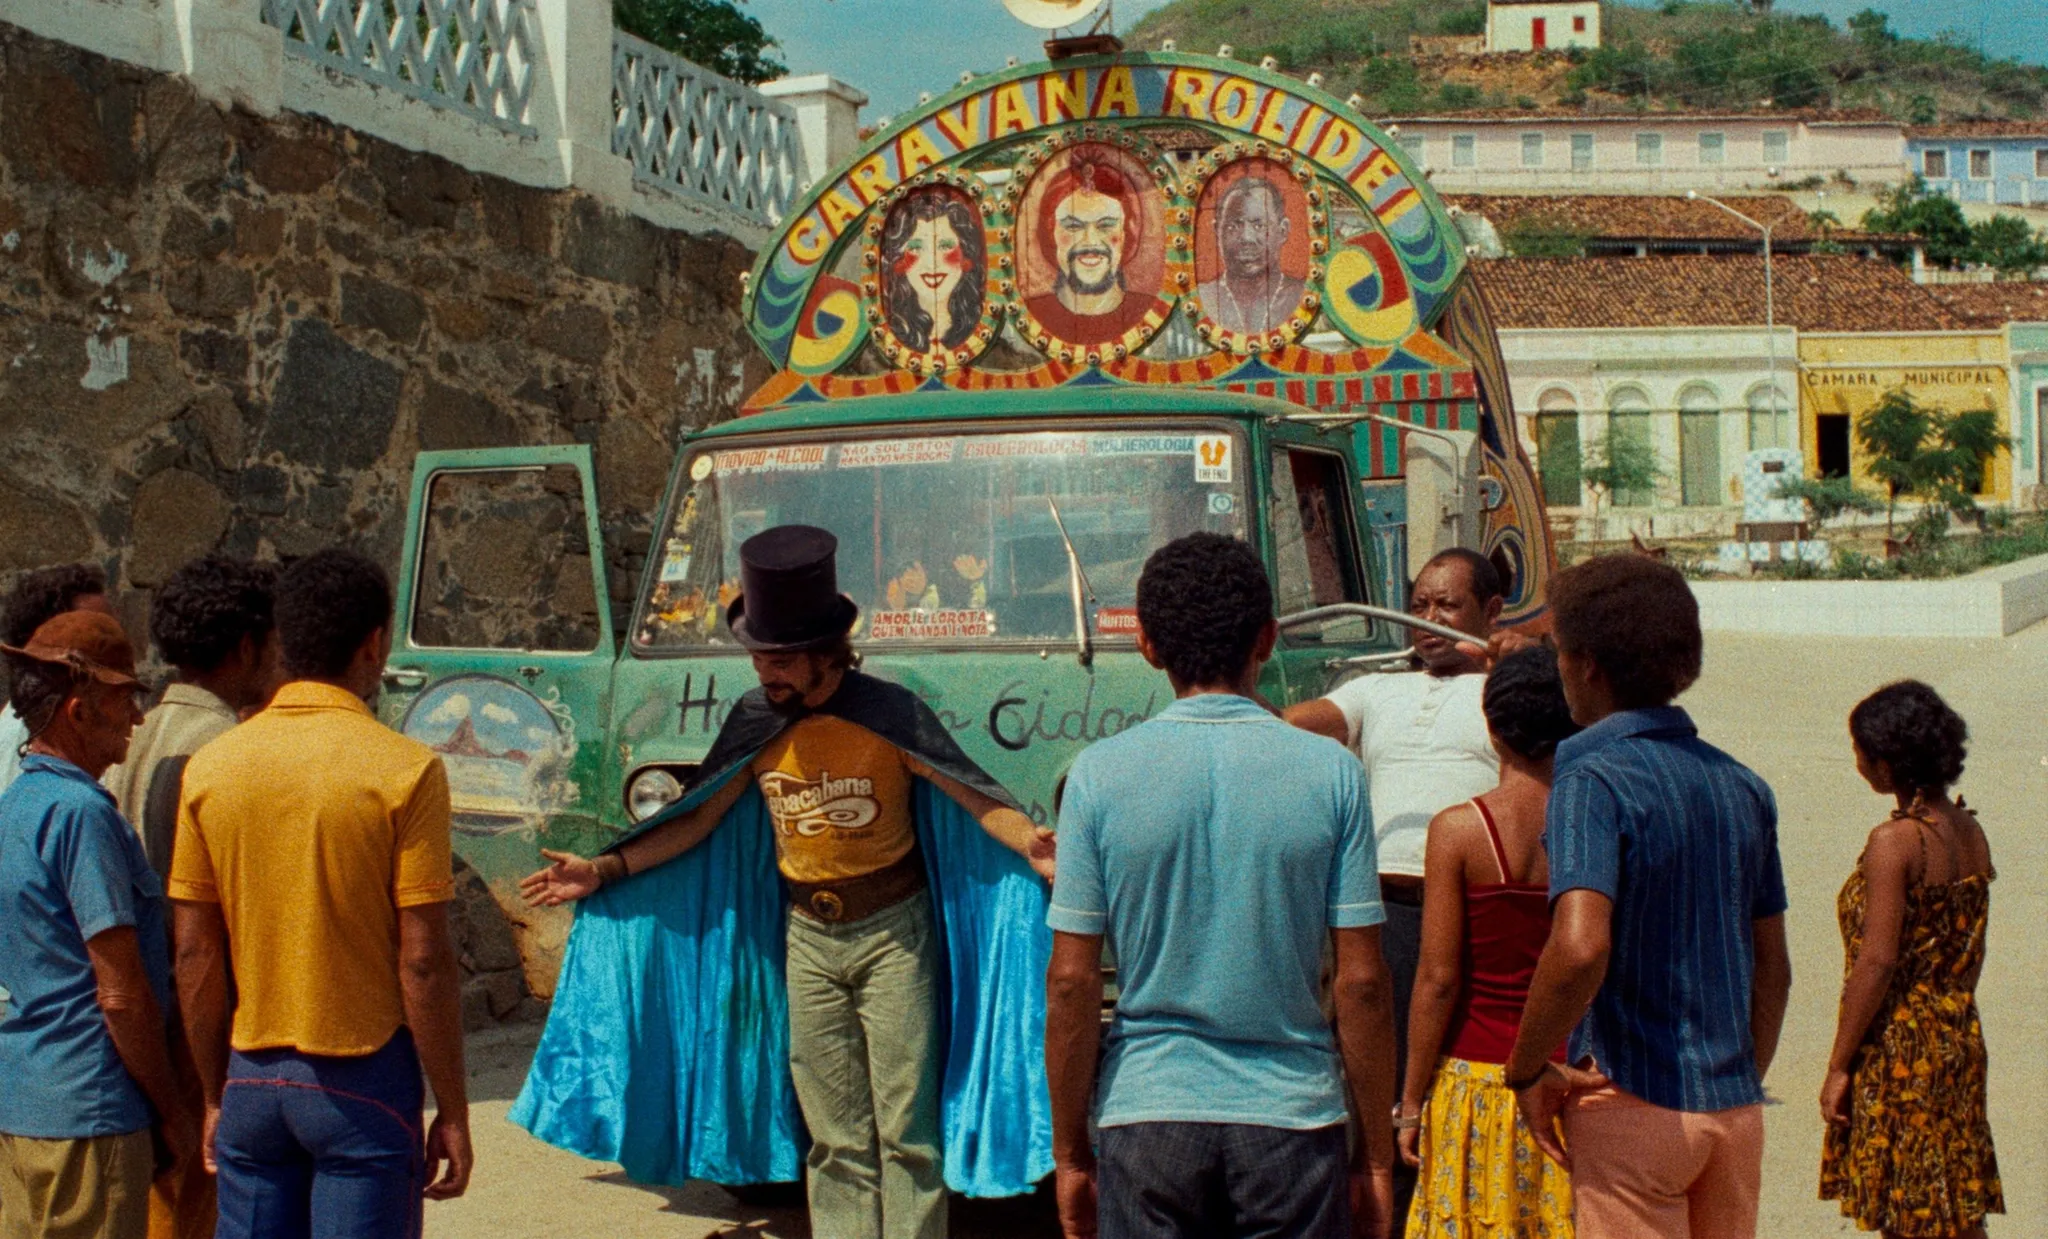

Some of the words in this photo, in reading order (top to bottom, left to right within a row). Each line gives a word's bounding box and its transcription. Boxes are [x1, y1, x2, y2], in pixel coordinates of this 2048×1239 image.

[787, 65, 1140, 266] CARAVANA
[1161, 67, 1422, 226] ROLIDEI
[1904, 370, 1993, 385] MUNICIPAL
[713, 450, 768, 470] MOVIDO
[874, 612, 911, 625] AMOR
[930, 610, 987, 624] LOROTA
